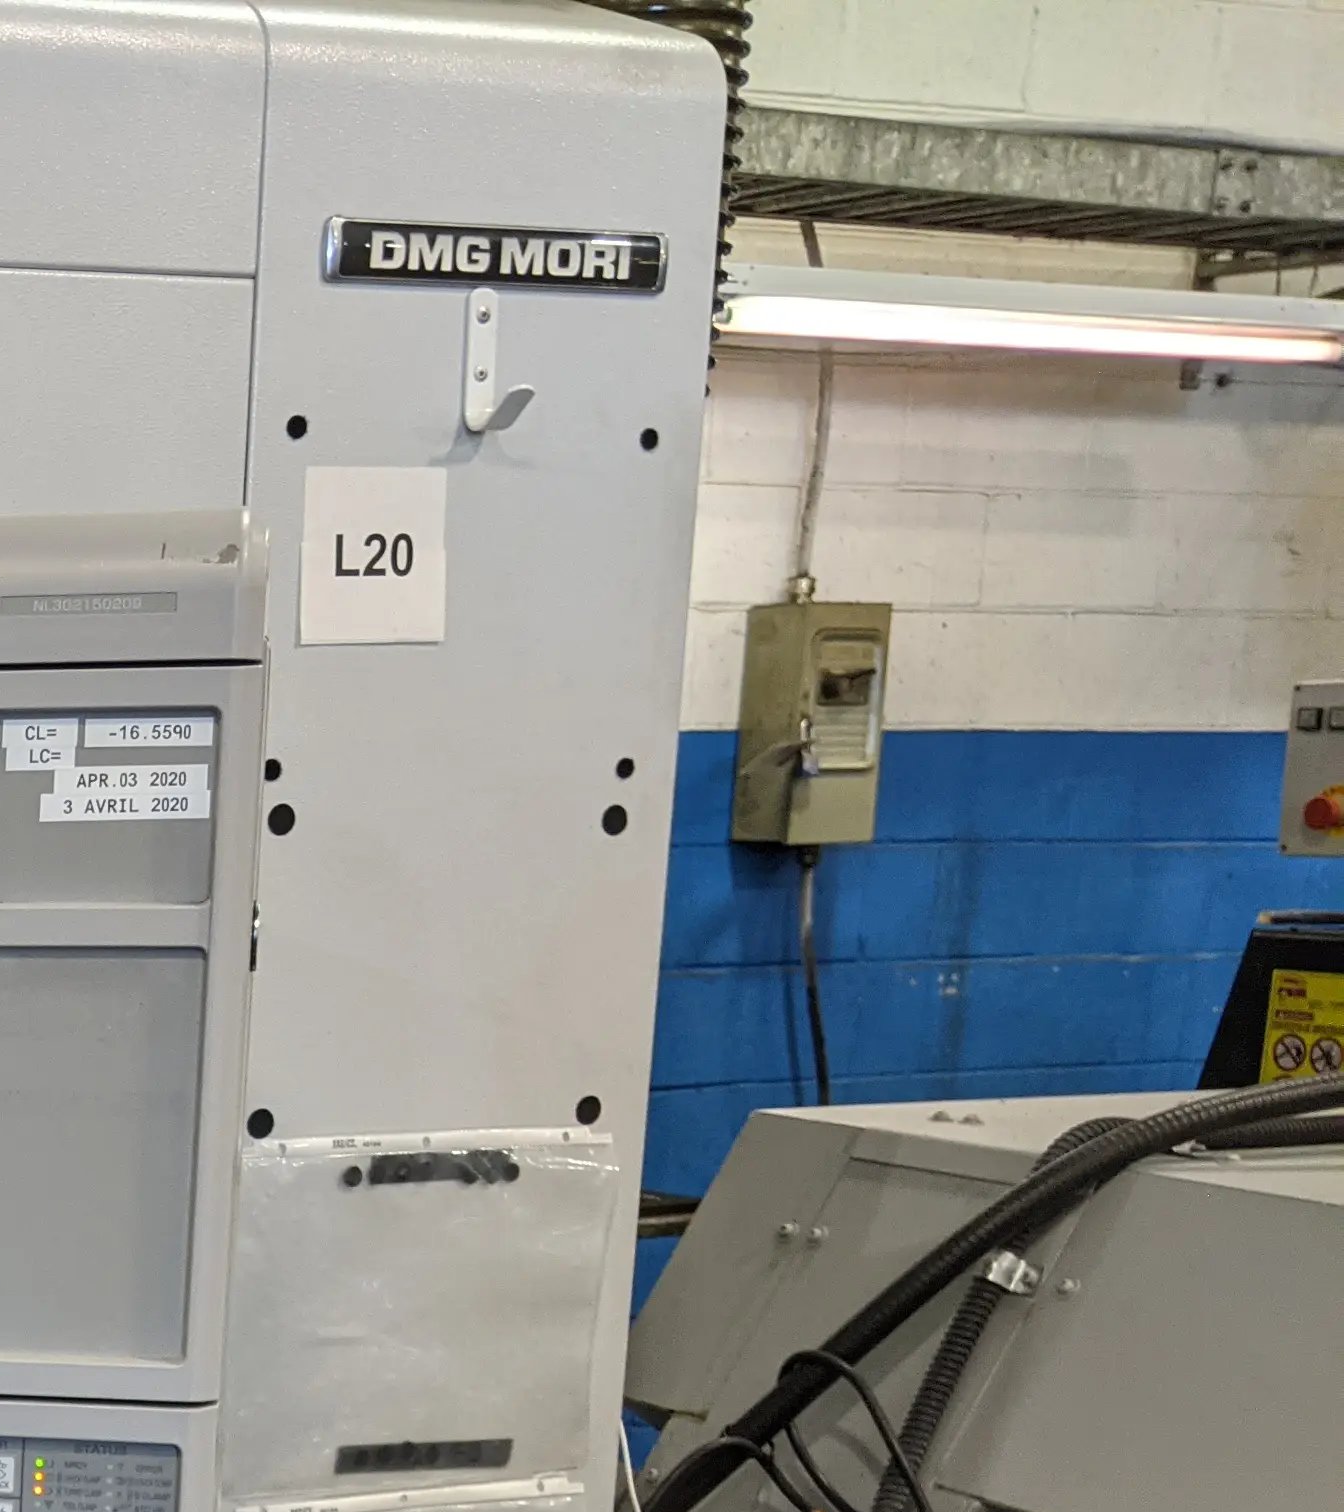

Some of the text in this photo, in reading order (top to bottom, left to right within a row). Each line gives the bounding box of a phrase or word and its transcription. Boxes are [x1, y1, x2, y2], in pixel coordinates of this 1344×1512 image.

[370, 231, 632, 280] DMG MORI
[335, 533, 413, 576] L20
[25, 724, 192, 741] CL= -16.5590
[29, 749, 61, 764] LC=
[77, 771, 187, 788] APR.03 2020
[63, 797, 189, 814] 3 AVRIL 2020
